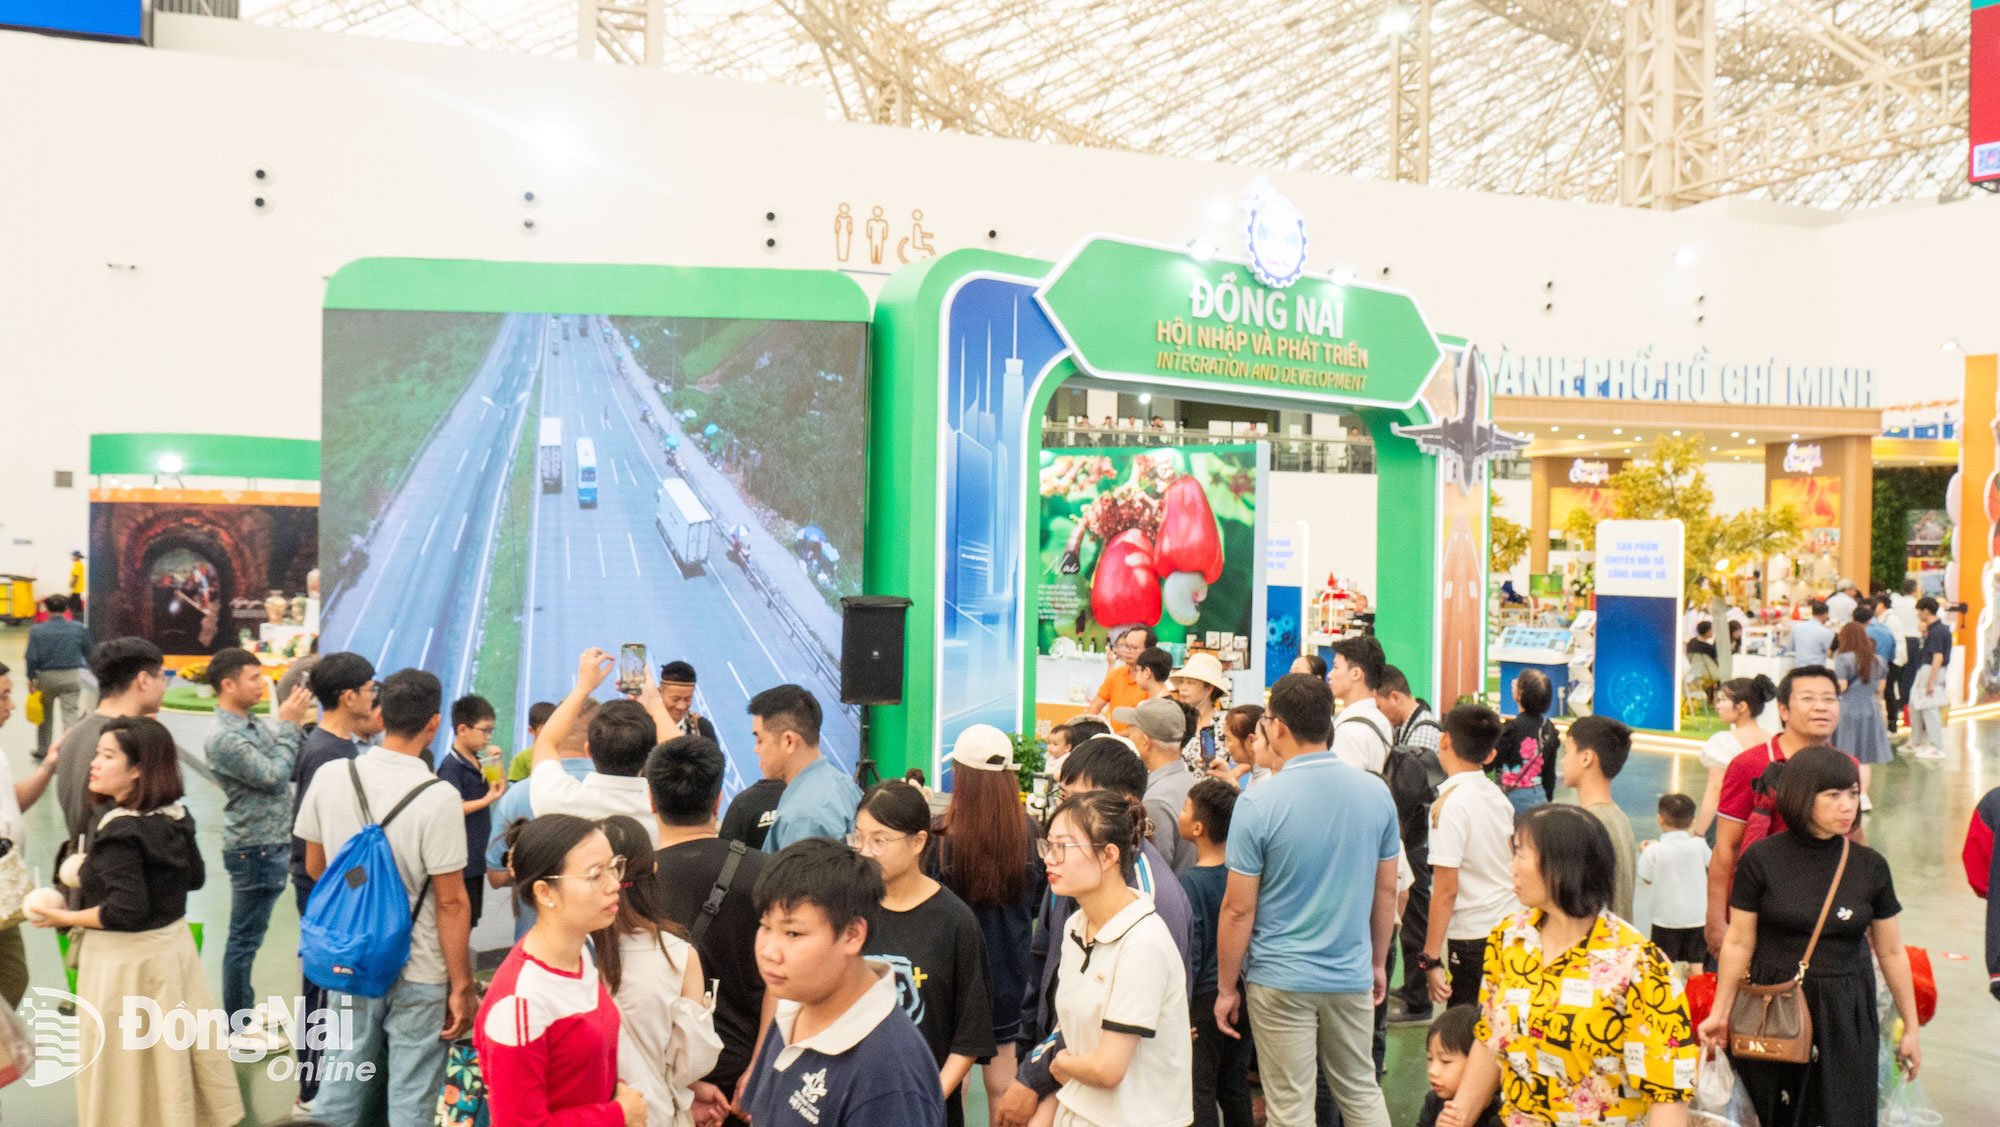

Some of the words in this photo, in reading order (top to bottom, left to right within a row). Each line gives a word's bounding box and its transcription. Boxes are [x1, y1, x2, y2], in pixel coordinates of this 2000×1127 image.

[1190, 271, 1287, 331] ĐỒNG
[1296, 294, 1344, 340] NAI
[1157, 316, 1192, 351] HỘI
[1197, 324, 1248, 357] NHẬP
[1251, 328, 1273, 357] VÀ
[1277, 335, 1320, 362] PHÁT
[1156, 351, 1248, 378] INTEGRATION
[1250, 363, 1278, 382] AND
[1281, 366, 1367, 392] DEVELOPMENT
[1494, 343, 1570, 398] ÀNH
[1583, 344, 1660, 401] PHỐ
[1664, 346, 1710, 402] HỒ
[1722, 357, 1776, 406] CHÍ
[1786, 366, 1876, 408] MINH
